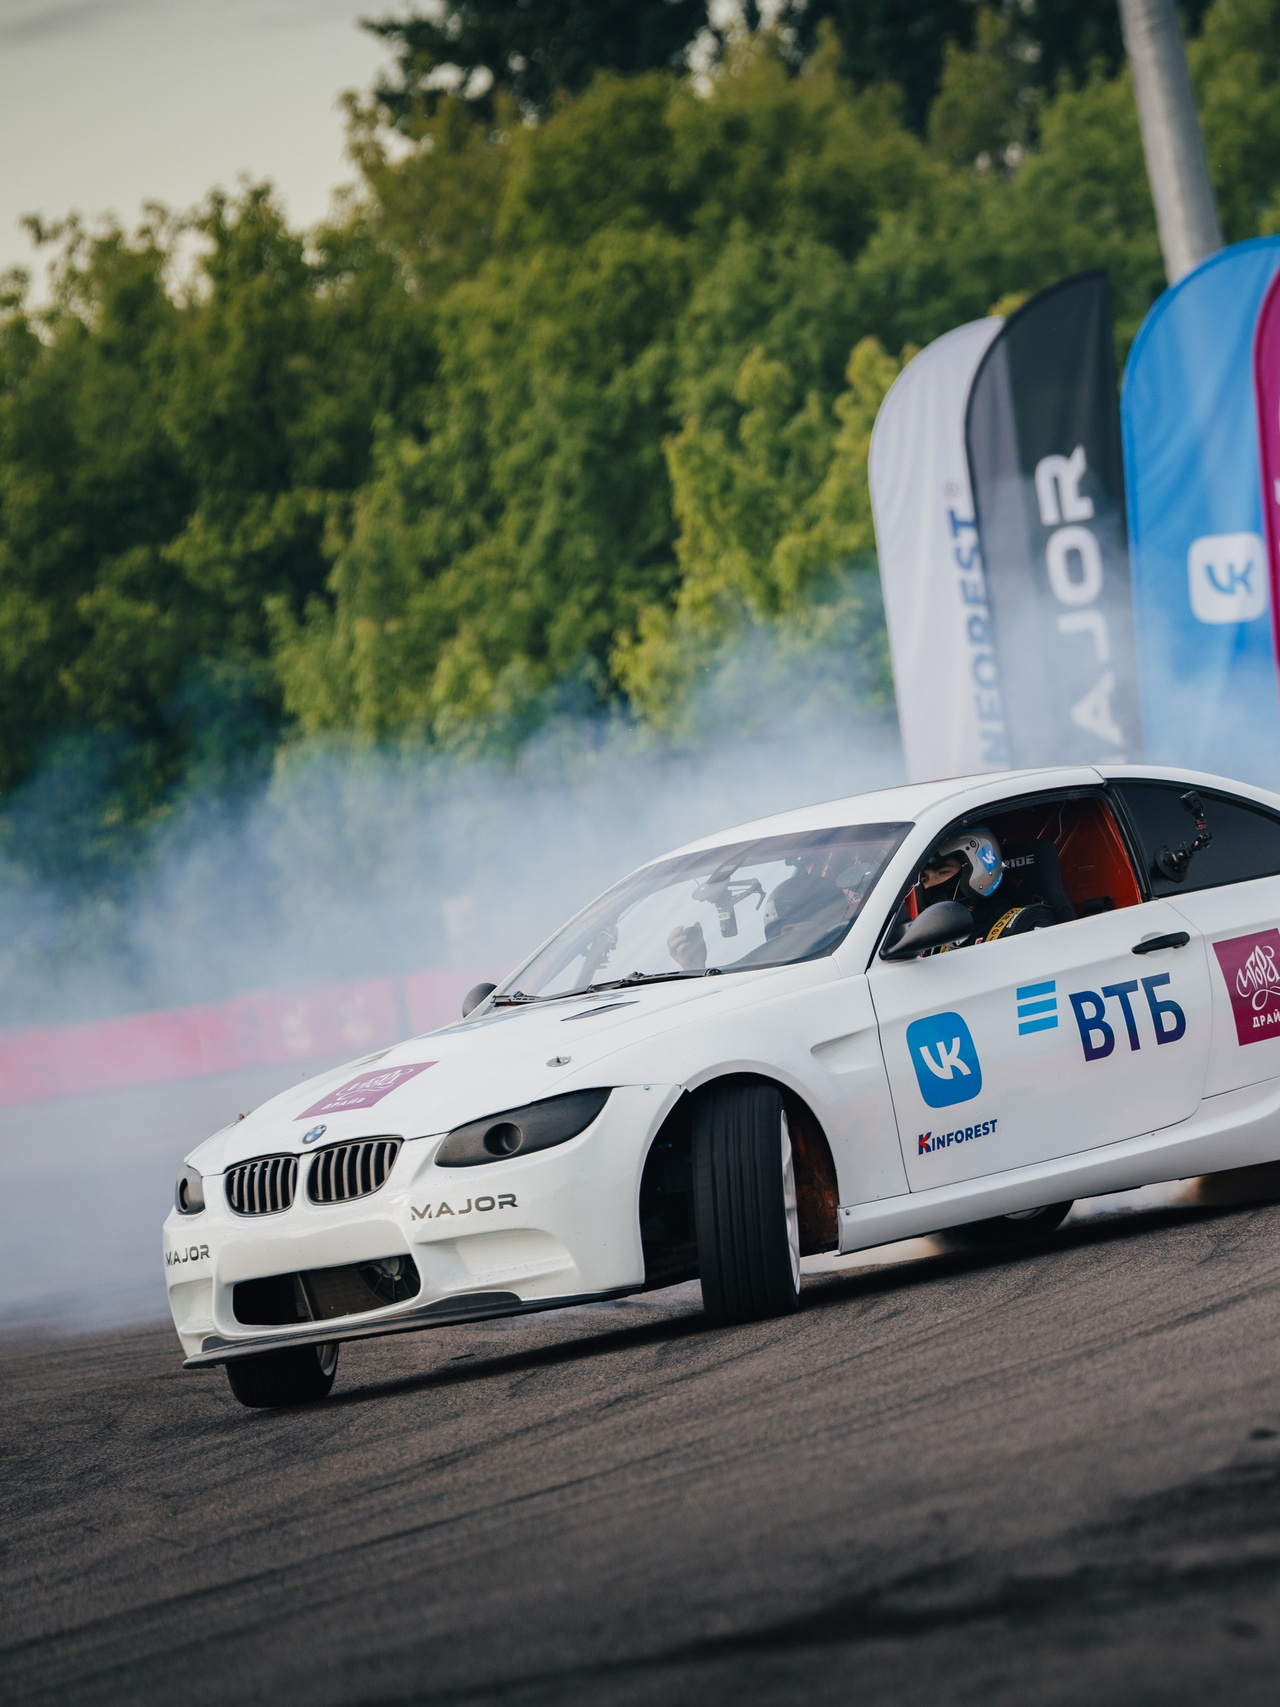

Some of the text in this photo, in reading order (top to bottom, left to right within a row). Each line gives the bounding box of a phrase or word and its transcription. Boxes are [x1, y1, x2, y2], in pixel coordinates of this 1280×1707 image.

[1035, 445, 1127, 765] AJOR
[1069, 972, 1187, 1062] ВТБ
[917, 1118, 998, 1156] KINFOREST
[410, 1193, 519, 1221] MAJOR
[165, 1244, 211, 1267] MAJOR
